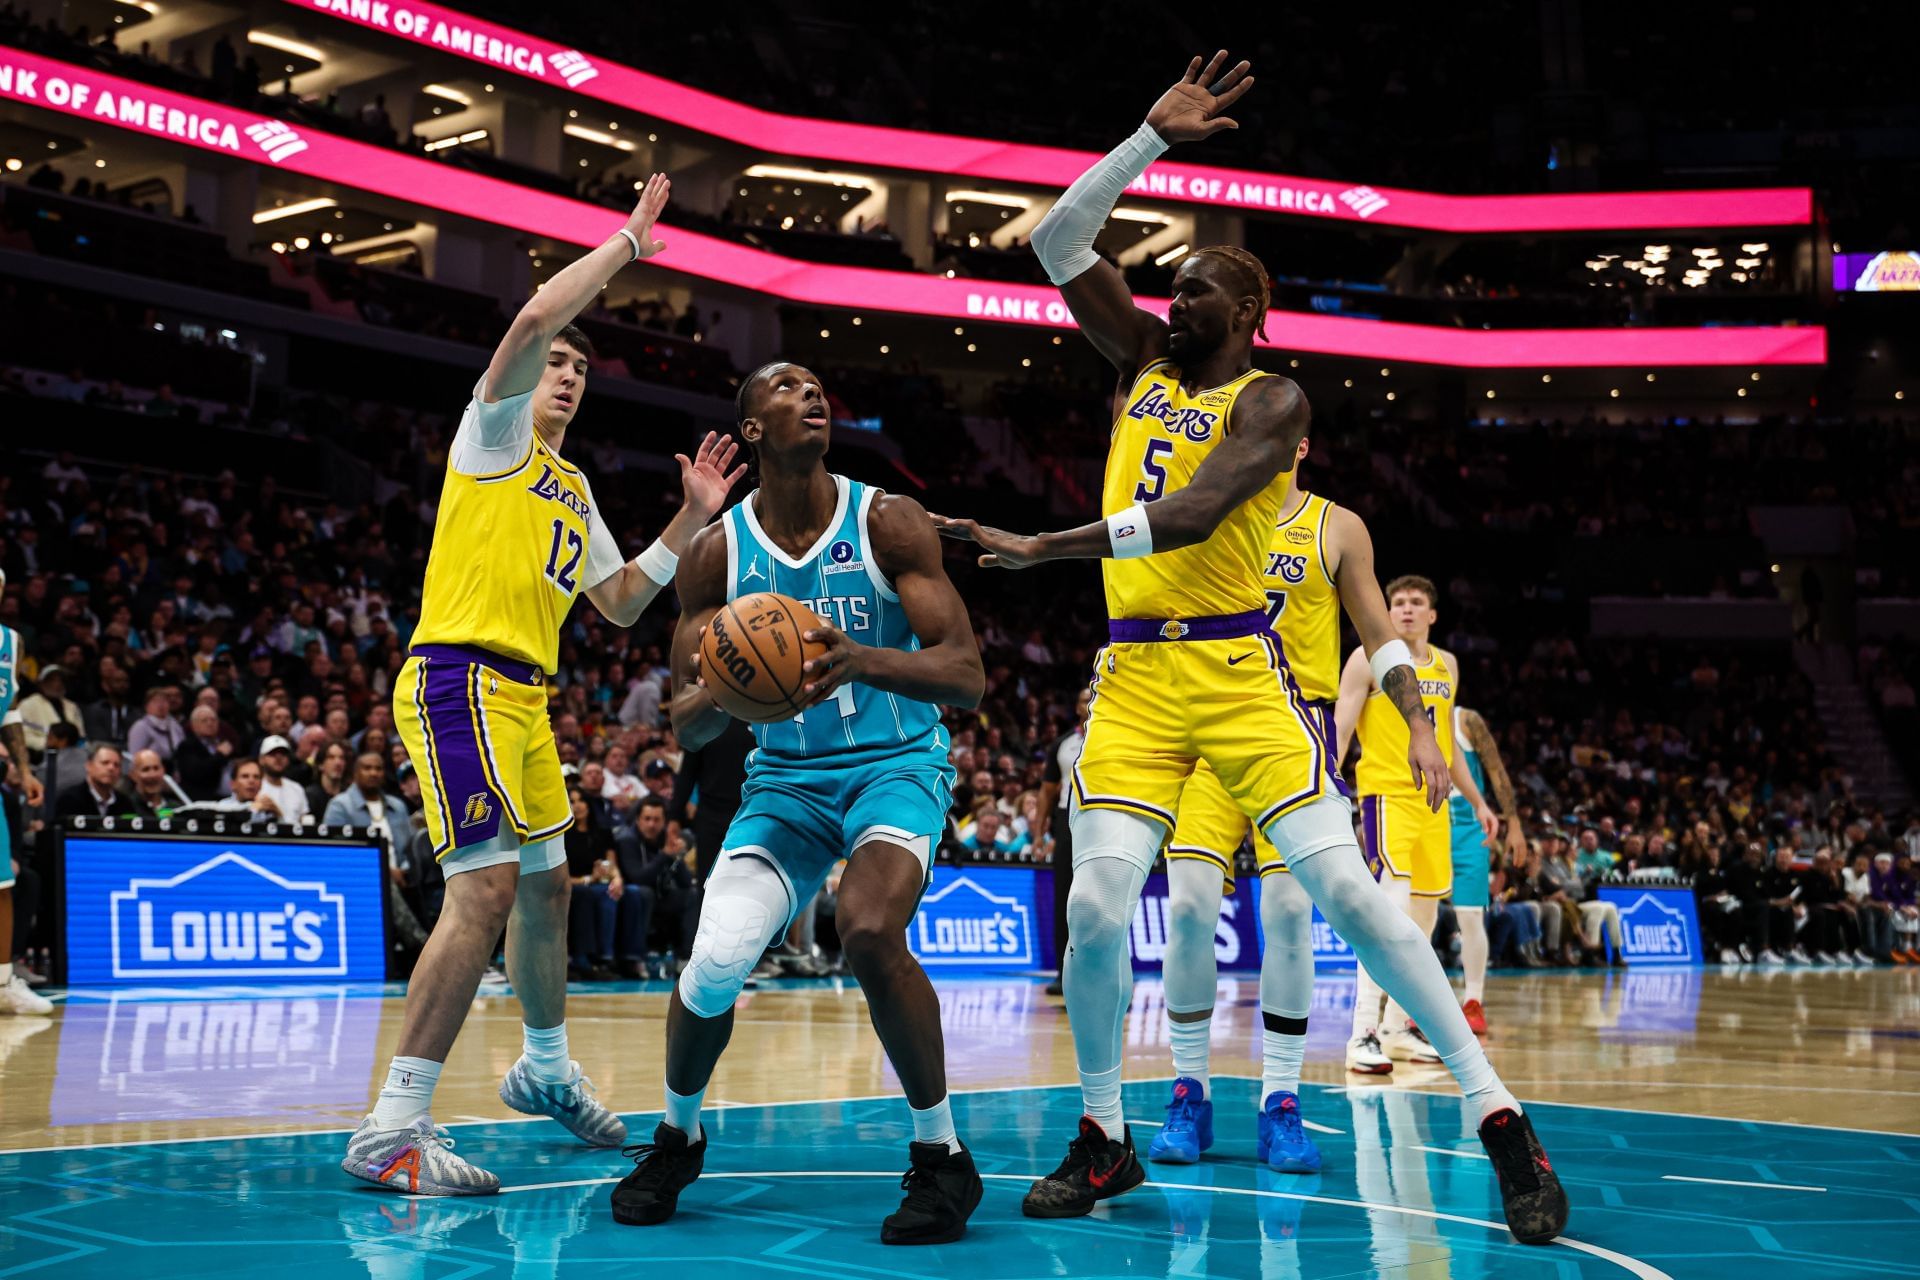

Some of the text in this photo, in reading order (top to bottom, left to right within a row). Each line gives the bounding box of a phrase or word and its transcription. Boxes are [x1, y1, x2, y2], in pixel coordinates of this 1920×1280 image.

[393, 9, 429, 37] OF
[431, 21, 546, 77] AMERICA
[45, 77, 90, 110] OF
[94, 90, 241, 151] AMERICA
[1127, 172, 1336, 214] ANK OF AMERICA
[967, 293, 1040, 321] BANK
[1133, 438, 1174, 503] 5
[1287, 530, 1313, 541] bibigo
[545, 518, 584, 599] 12
[826, 562, 863, 574] Judi Health
[1264, 551, 1308, 585] RS
[139, 901, 324, 962] LOWE'S
[917, 910, 1019, 955] LOWE'S
[1623, 920, 1683, 954] LOWE'S
